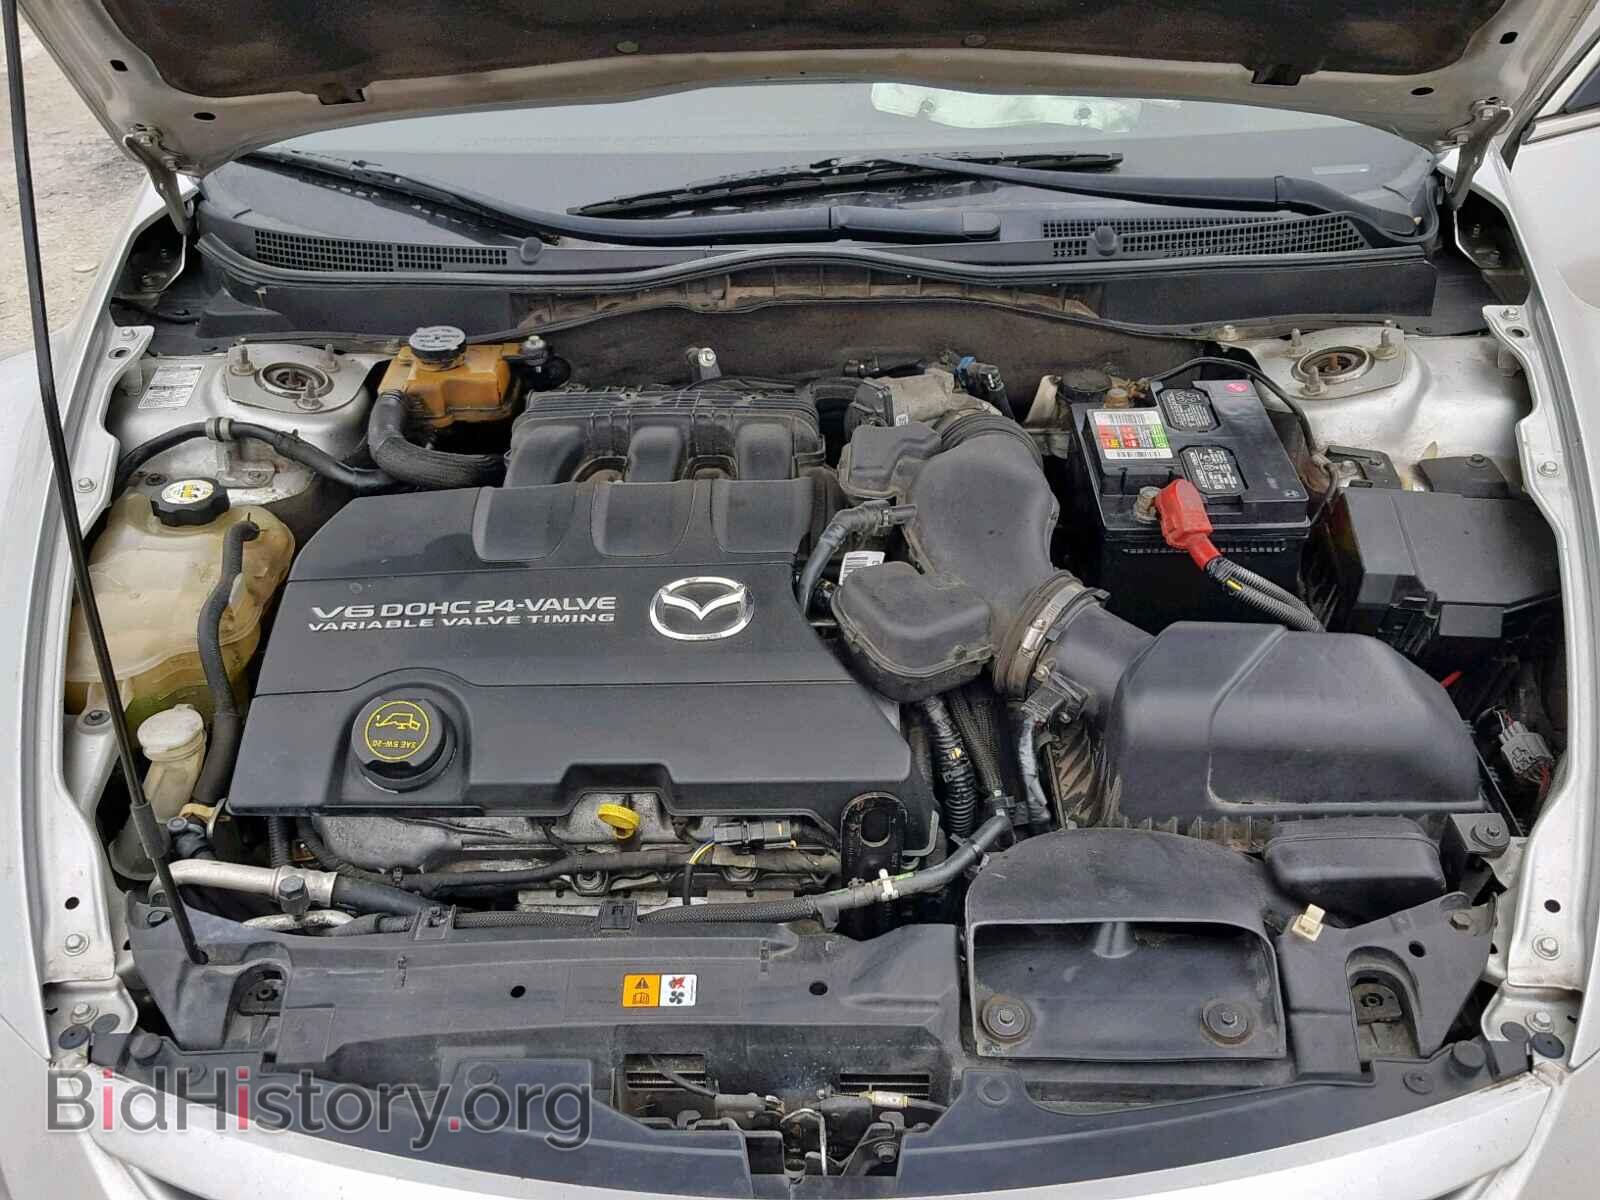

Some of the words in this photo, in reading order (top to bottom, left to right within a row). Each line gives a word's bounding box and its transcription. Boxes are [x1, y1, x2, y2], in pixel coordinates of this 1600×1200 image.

[311, 604, 377, 618] V6
[380, 600, 474, 617] DOHC
[475, 596, 617, 613] 24-VALVE
[308, 618, 435, 632] VARIABLE
[441, 614, 521, 626] VALVE
[527, 612, 616, 624] TIMING
[400, 740, 417, 749] SAE
